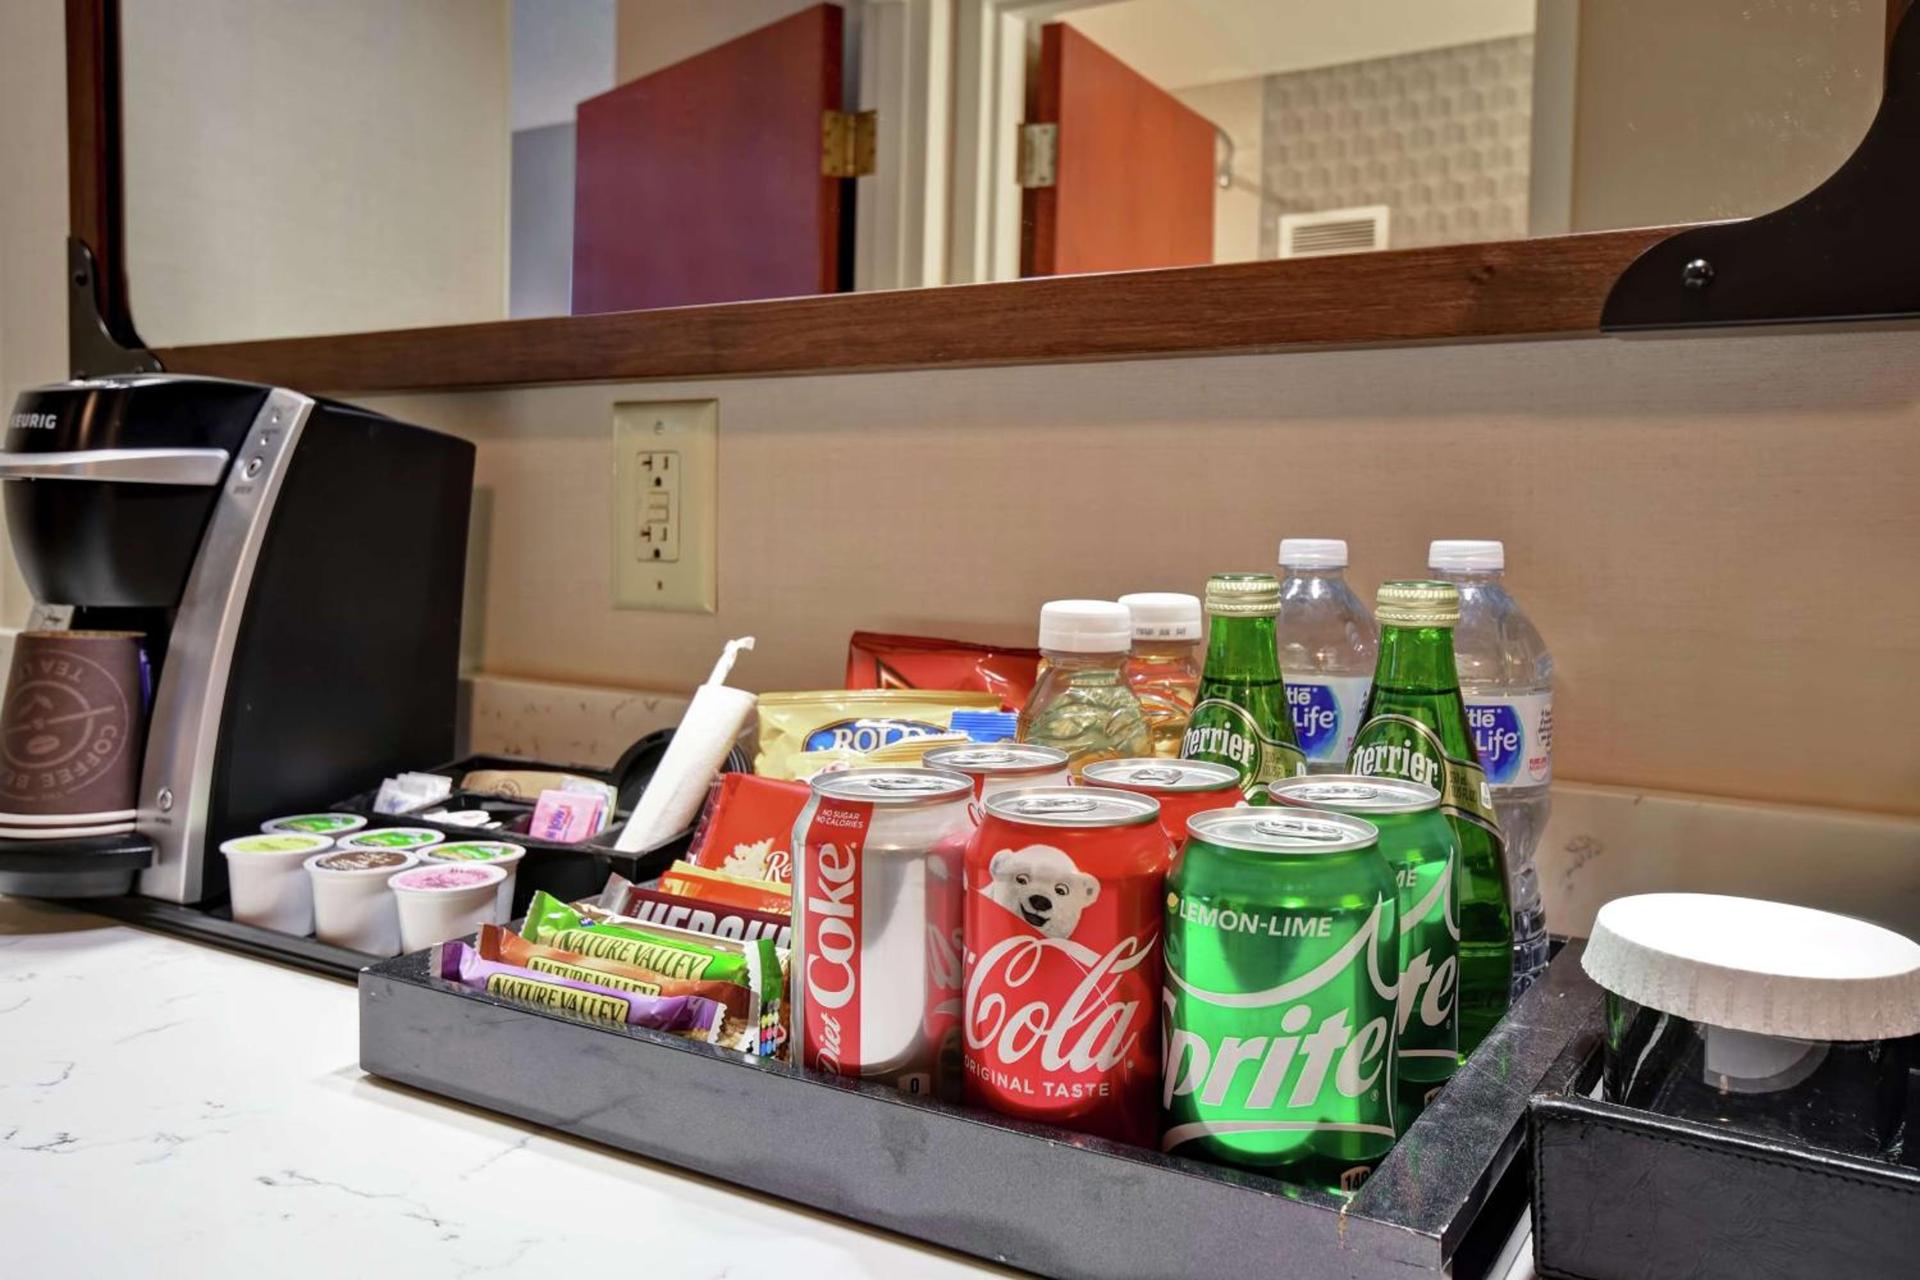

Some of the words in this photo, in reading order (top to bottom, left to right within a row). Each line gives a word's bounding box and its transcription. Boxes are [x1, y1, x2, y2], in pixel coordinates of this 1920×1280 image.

[40, 659, 83, 683] TEA
[1293, 706, 1334, 737] Life
[41, 724, 118, 788] COFFEE
[1476, 729, 1518, 760] Life
[816, 816, 825, 824] NO
[826, 817, 864, 829] CALORIES
[822, 809, 833, 817] NO
[834, 810, 861, 820] SUGAR
[807, 843, 856, 1009] Coke
[1179, 899, 1334, 938] LEMON-LIME
[559, 931, 632, 963] NATURE
[632, 945, 707, 980] VALLEY
[493, 976, 559, 1003] NATURE
[559, 992, 626, 1021] VALLEY
[965, 932, 1159, 1072] Cola
[815, 1011, 842, 1076] Diet
[965, 1054, 1035, 1095] ORIGINAL
[1043, 1081, 1110, 1098] TASTE
